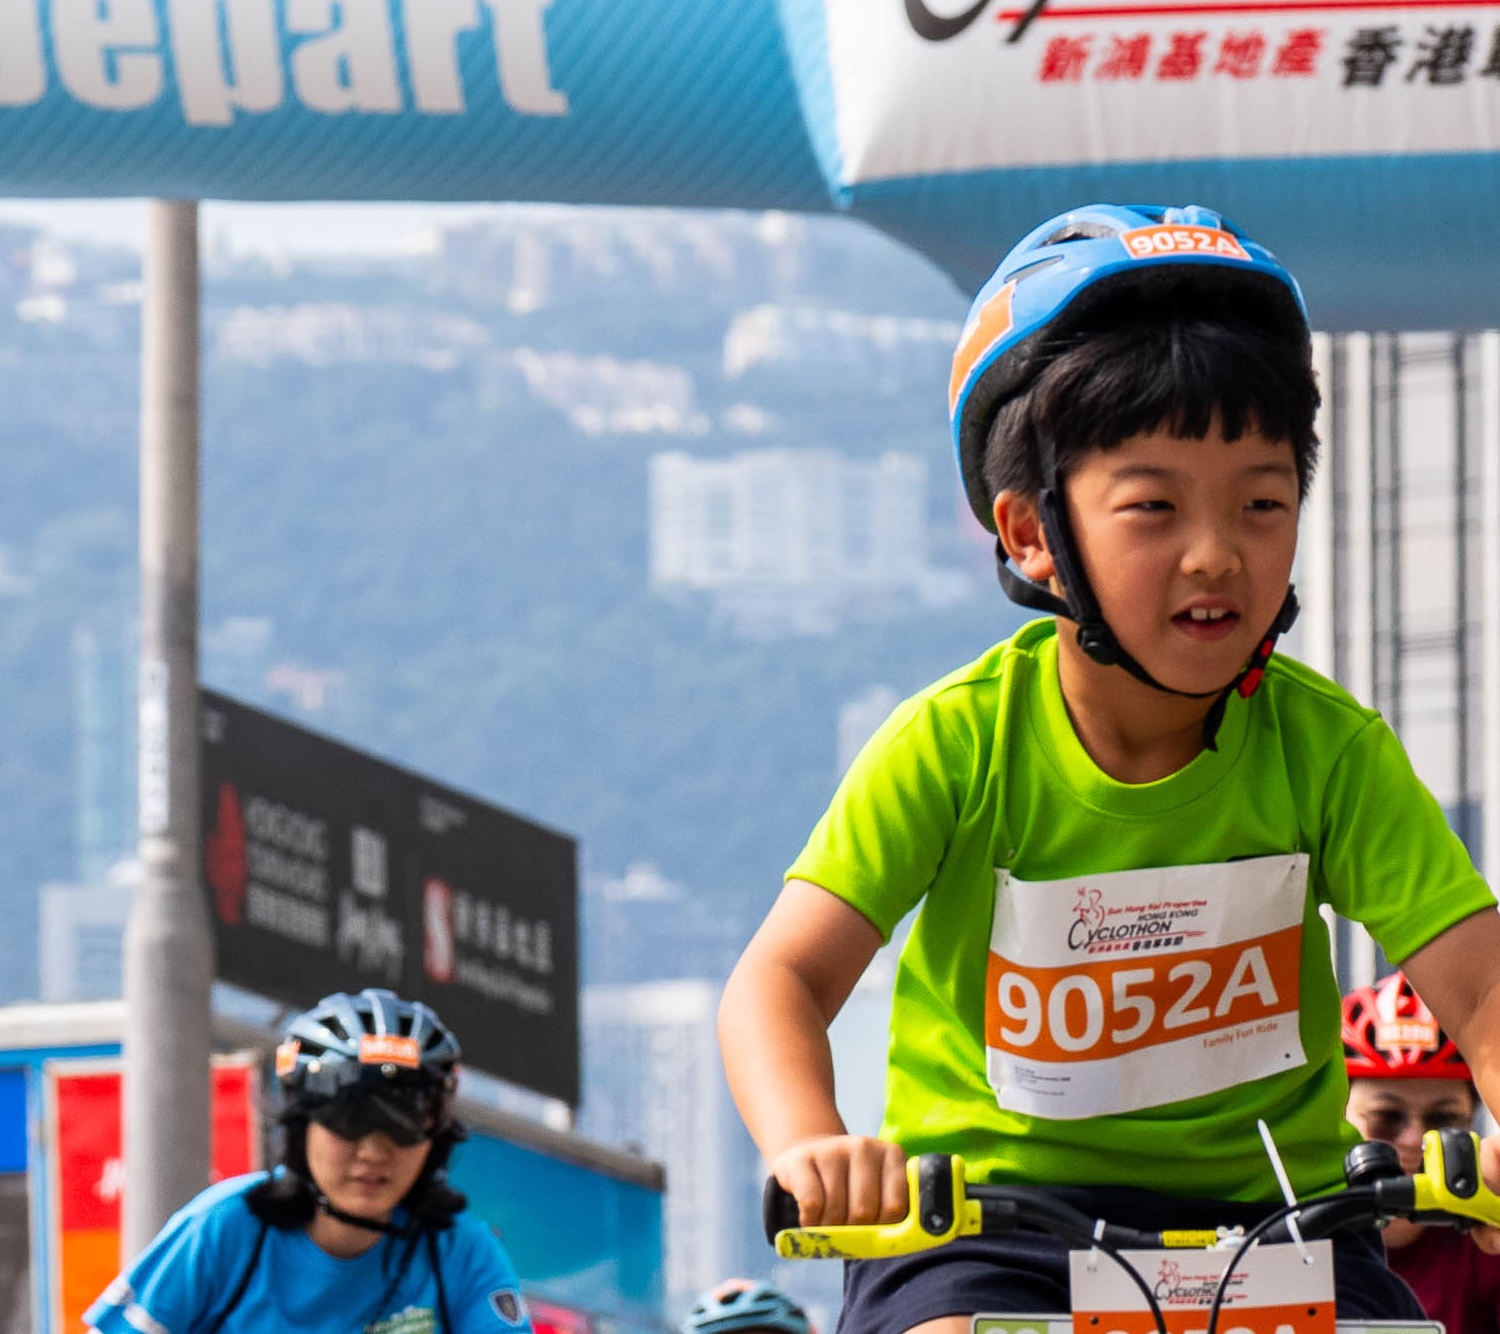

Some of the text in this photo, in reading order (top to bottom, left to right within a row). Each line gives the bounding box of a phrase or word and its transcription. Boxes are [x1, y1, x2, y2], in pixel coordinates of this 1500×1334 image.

[1130, 229, 1241, 256] 9052A
[998, 946, 1279, 1052] 9052A
[1203, 1021, 1279, 1049] Family Fun Ride
